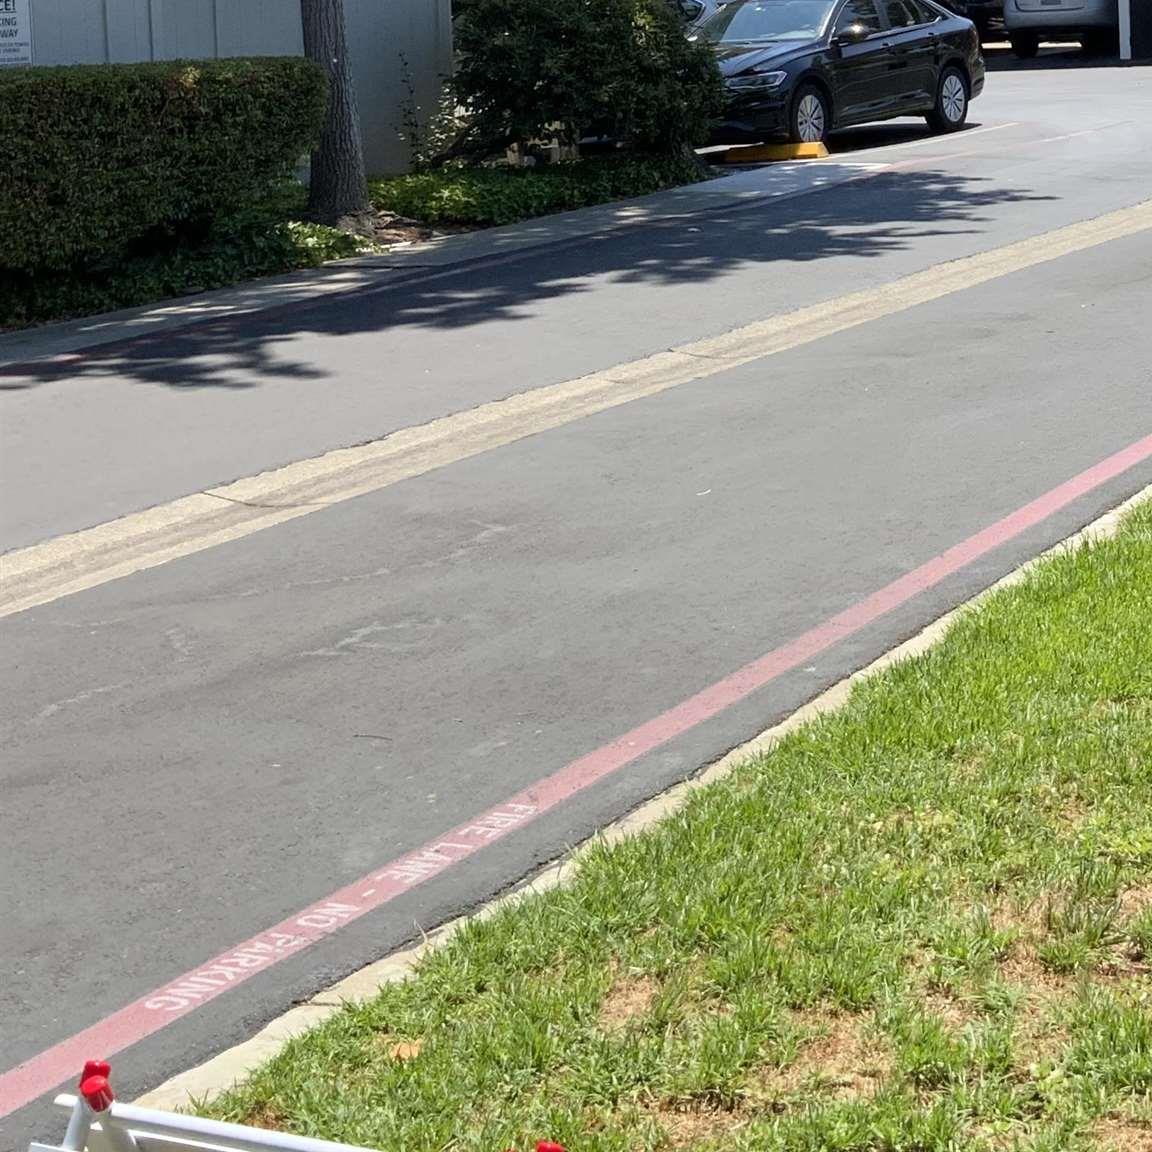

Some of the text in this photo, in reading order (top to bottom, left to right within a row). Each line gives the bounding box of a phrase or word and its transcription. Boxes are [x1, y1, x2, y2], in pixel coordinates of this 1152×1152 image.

[459, 803, 538, 839] FIRE
[376, 842, 473, 885] LANE
[297, 902, 360, 928] NO
[144, 933, 311, 1012] PARKING
